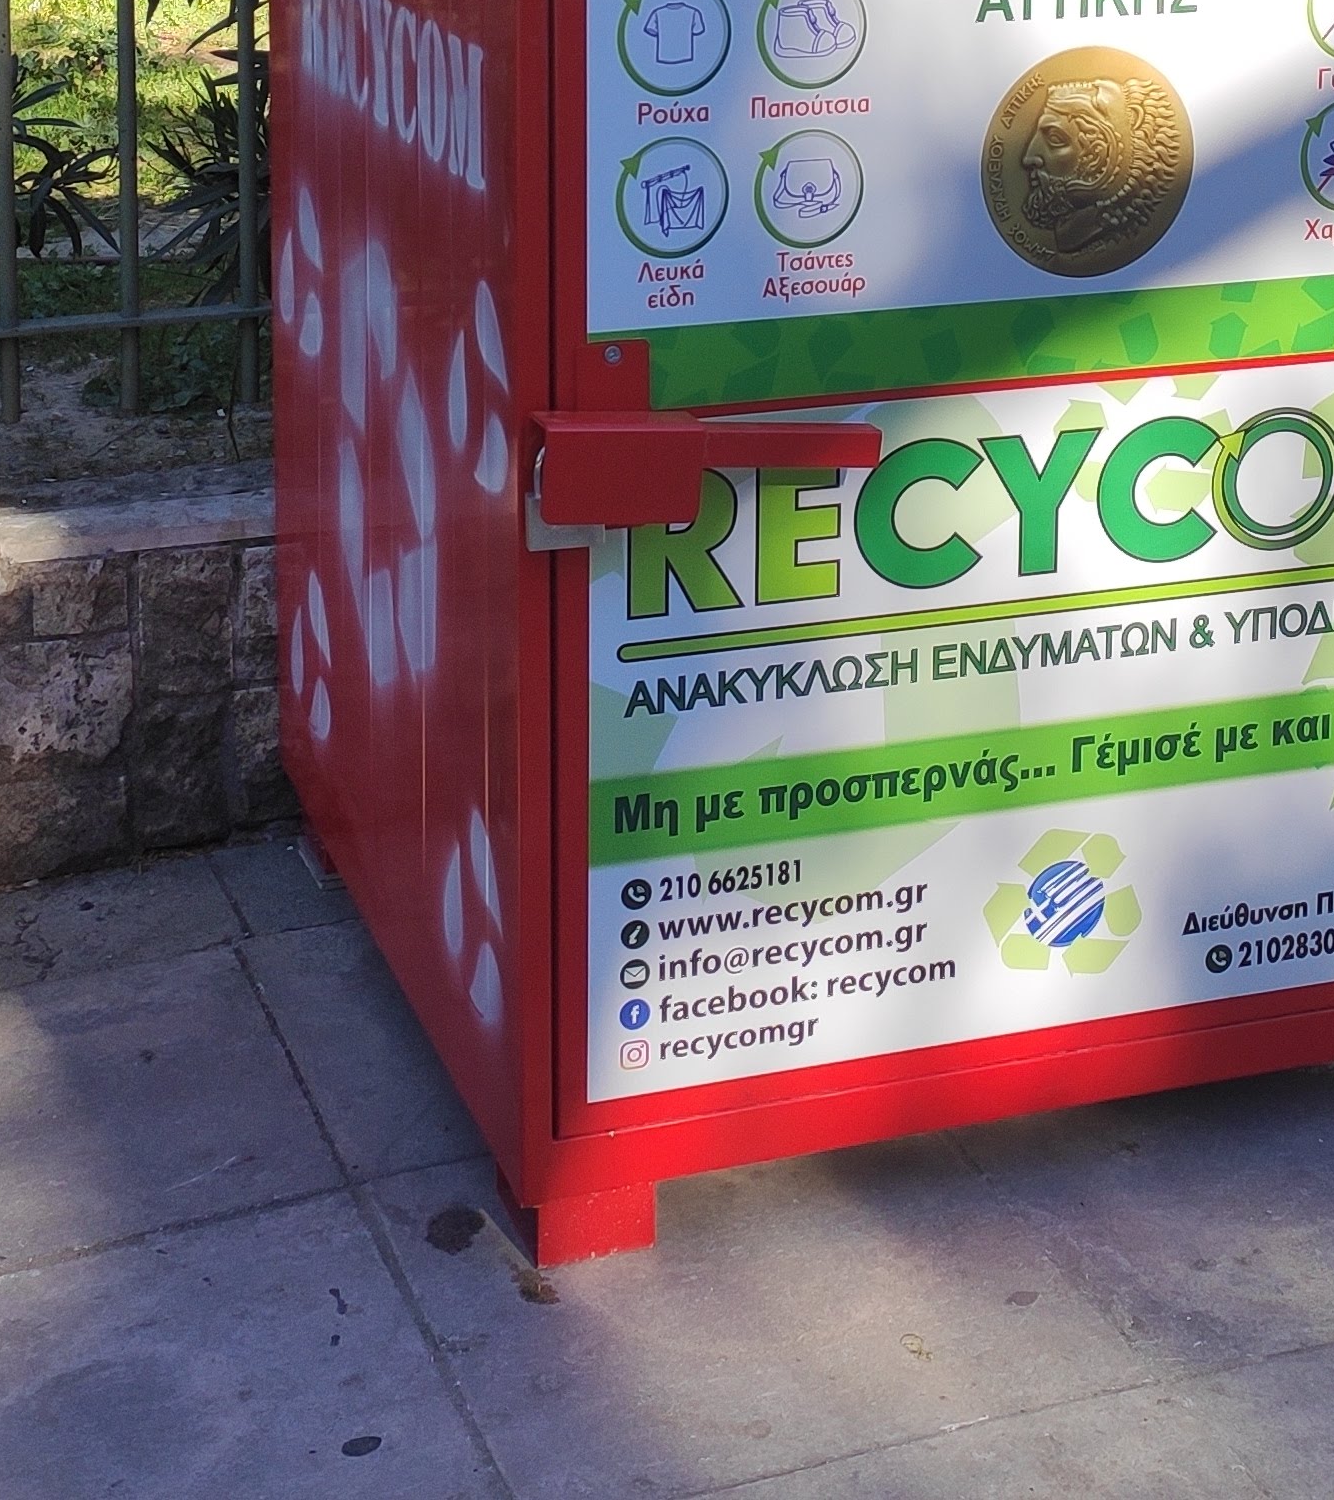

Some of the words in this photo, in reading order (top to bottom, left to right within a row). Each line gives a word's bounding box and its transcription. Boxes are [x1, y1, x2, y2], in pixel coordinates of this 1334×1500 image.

[637, 100, 710, 125] Ρούχα
[750, 93, 870, 119] Παπούτσια
[637, 258, 705, 283] Λευκά
[762, 272, 866, 302] Αξεσουάρ
[647, 284, 695, 309] είδη
[623, 647, 919, 718] ΑΝΑΚΥΚΛΩΣΗ
[932, 616, 1177, 681] ΕΝΔΥΜΑΤΩΝ
[1188, 613, 1216, 650] &
[613, 792, 679, 837] Μη
[695, 790, 745, 833] με
[758, 748, 1056, 821] προσπερνάς...
[1070, 721, 1203, 777] Γέμισέ
[1214, 721, 1259, 763] με
[1271, 713, 1332, 746] και
[658, 872, 702, 904] 210
[708, 858, 803, 896] 6625181
[657, 882, 929, 941] www.recycom.gr
[1181, 900, 1308, 936] Διεύθυνση
[657, 921, 929, 983] info@recycom.gr
[659, 975, 819, 1024] facebook:
[826, 958, 957, 998] recycom
[658, 1017, 820, 1061] recycomgr
